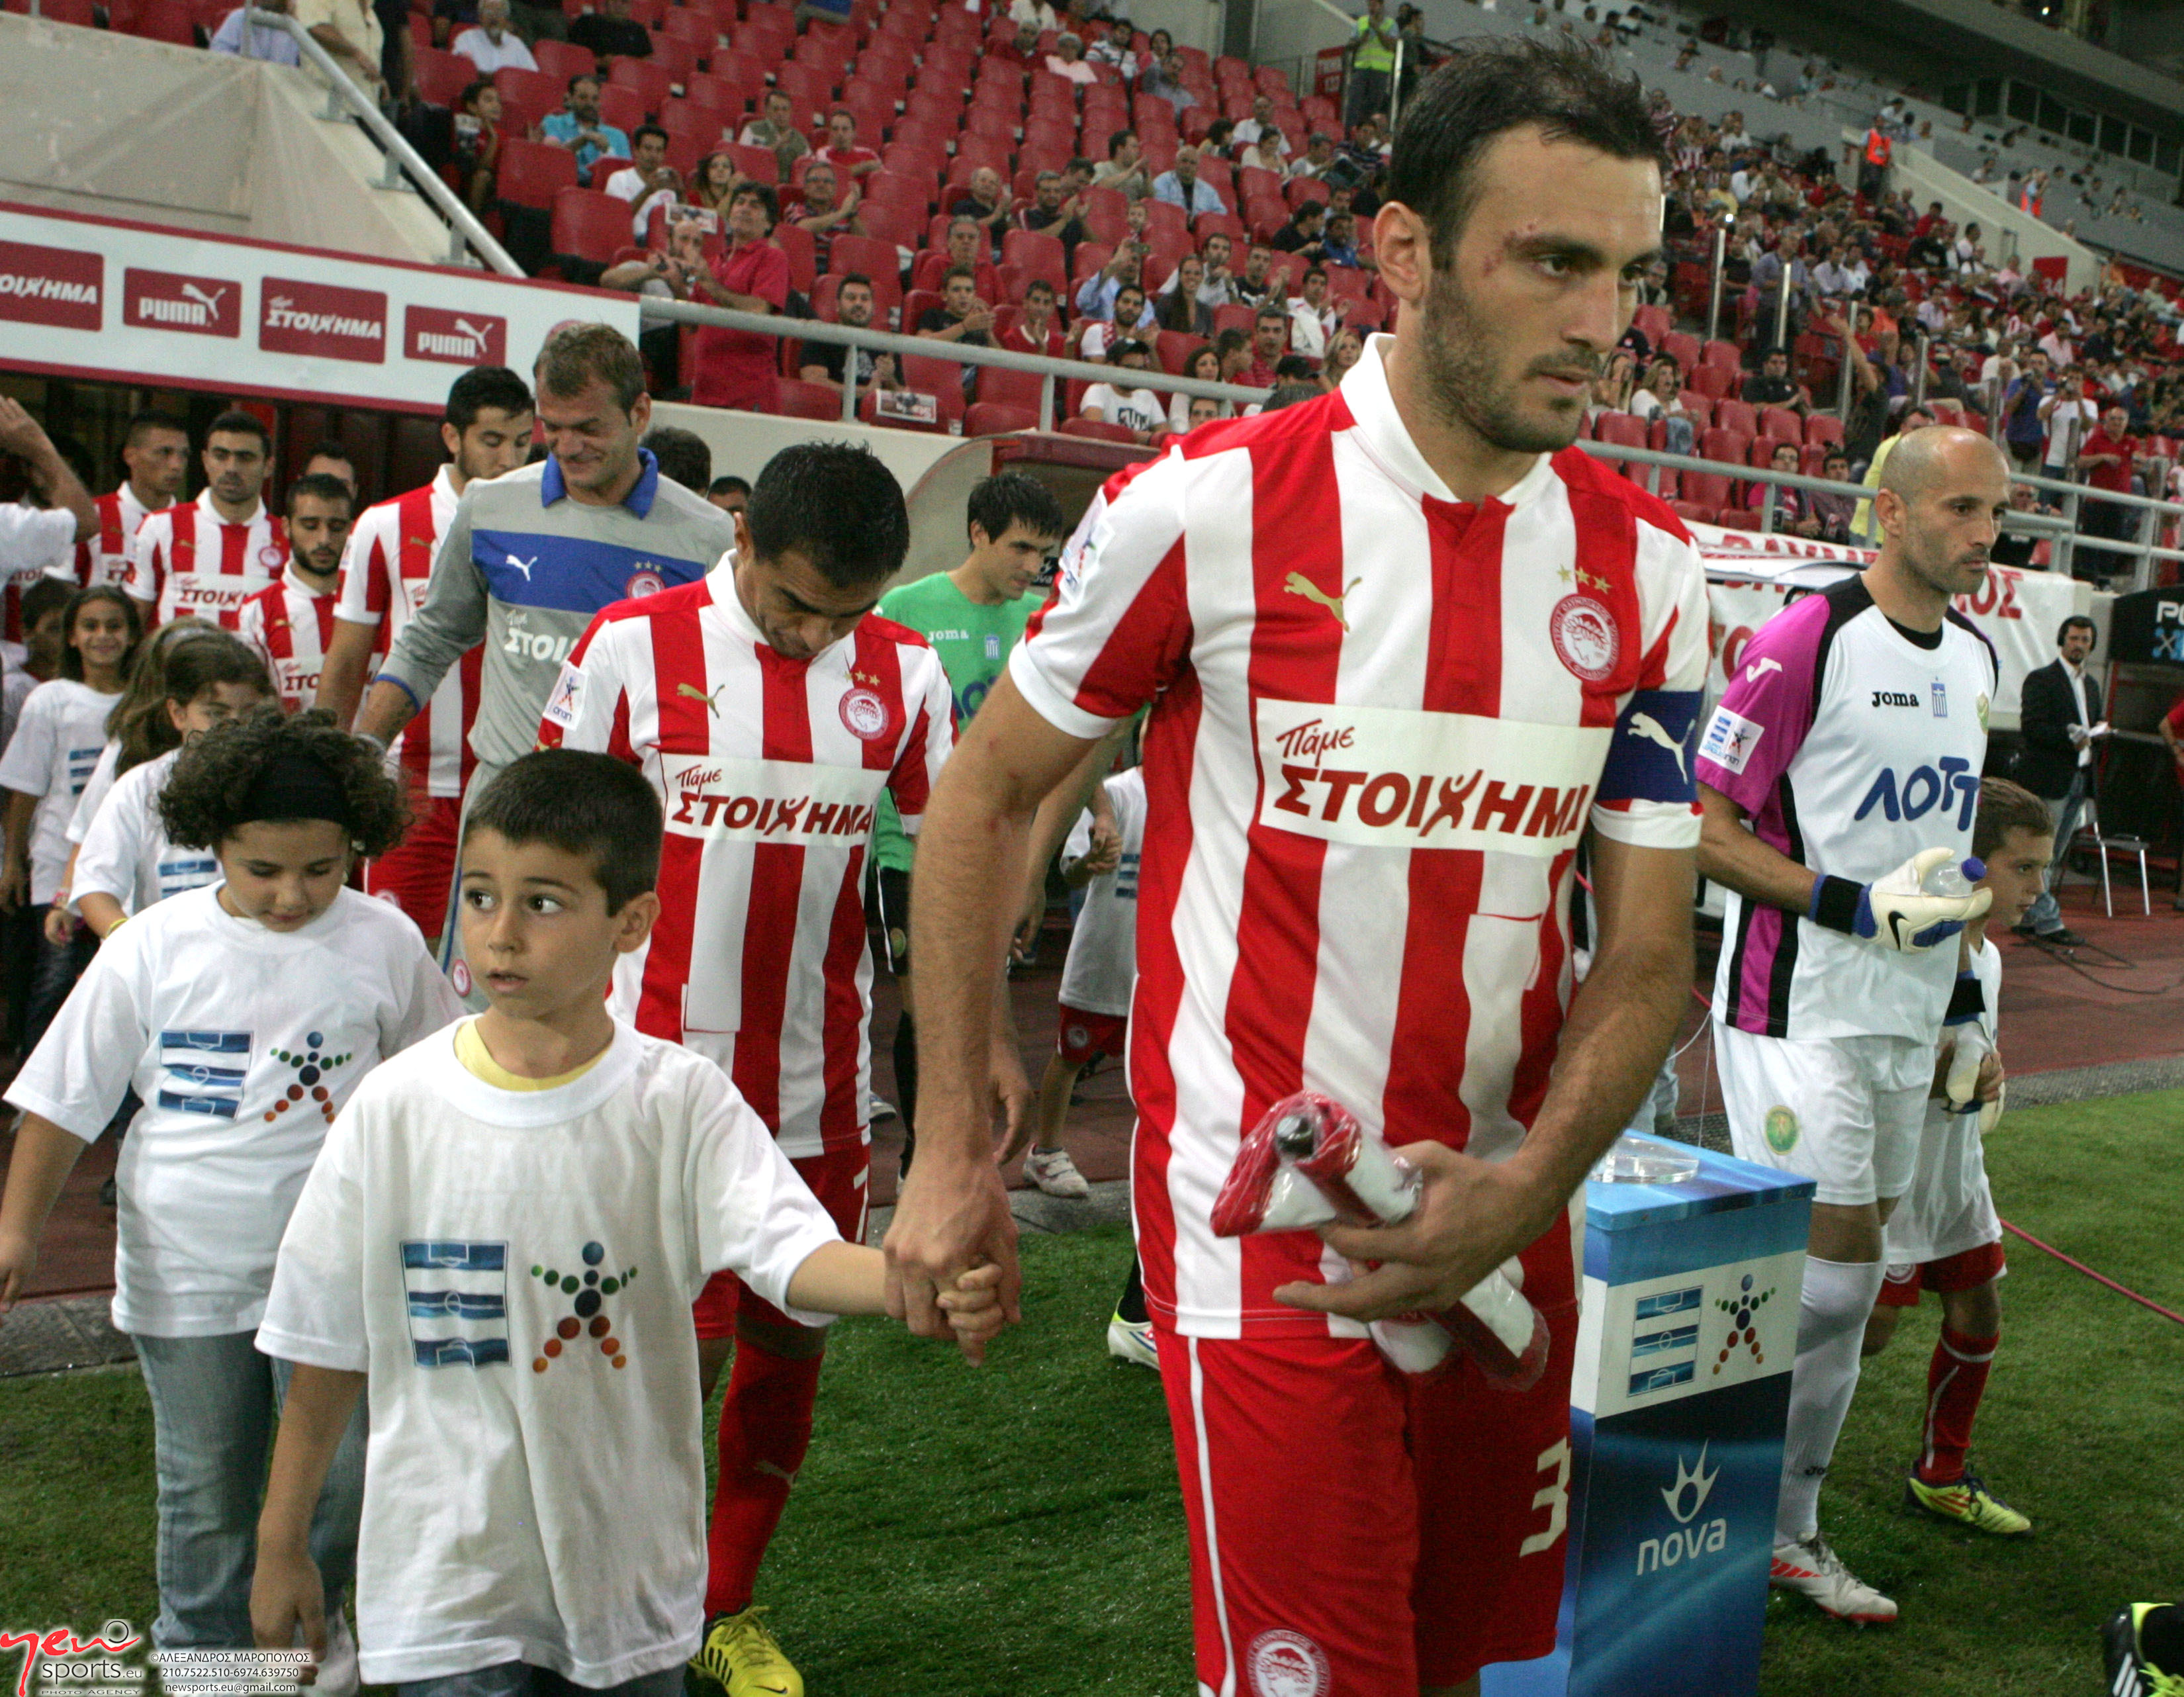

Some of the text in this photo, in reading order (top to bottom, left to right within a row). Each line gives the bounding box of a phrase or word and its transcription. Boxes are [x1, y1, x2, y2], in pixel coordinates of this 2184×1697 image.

[0, 273, 97, 304] ΟΙΧΗΜΑ
[138, 297, 207, 326] PUMA
[417, 332, 476, 358] PUMA
[179, 588, 249, 605] ΣΤΟΙΧ
[1277, 719, 1355, 765] Πάμε
[675, 764, 722, 795] Πάμε
[1637, 1516, 1727, 1576] nova
